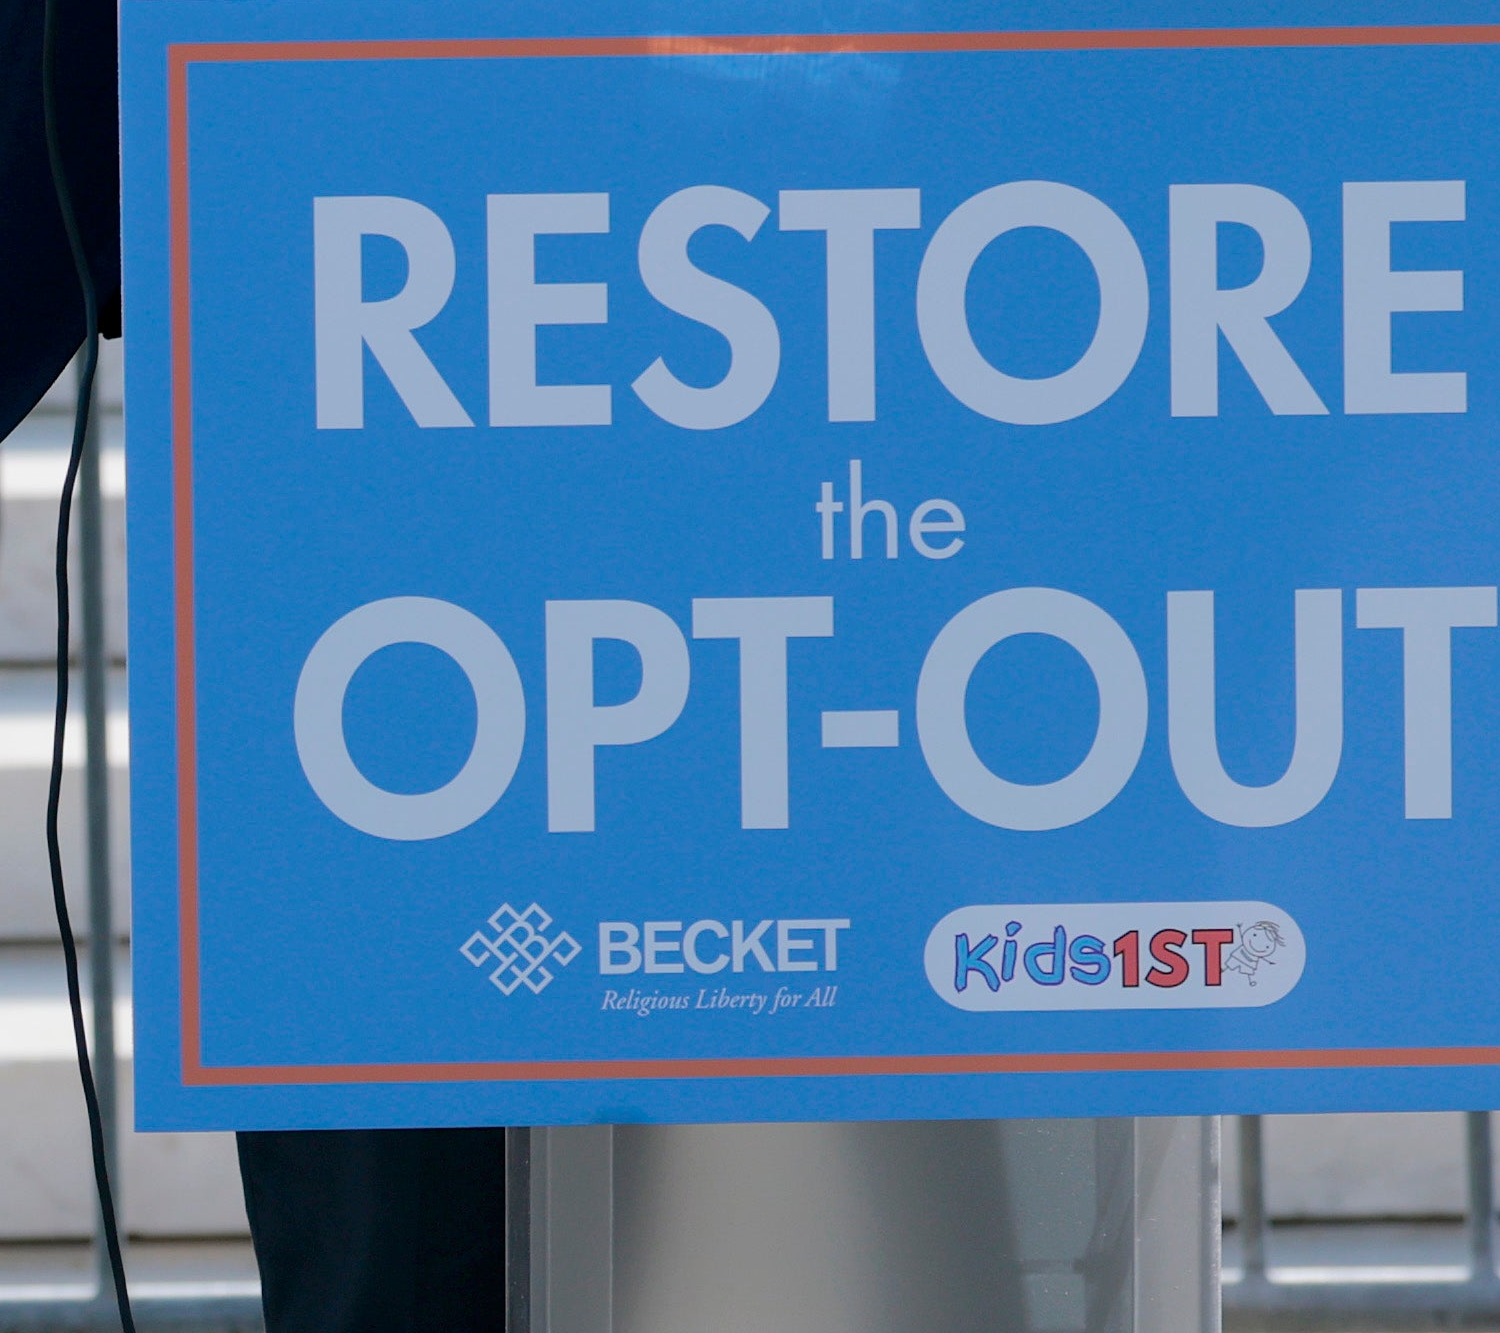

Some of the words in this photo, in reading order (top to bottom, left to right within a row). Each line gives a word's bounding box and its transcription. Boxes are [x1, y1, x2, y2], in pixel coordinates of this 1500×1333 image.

[313, 180, 1467, 430] RESTORE
[816, 459, 965, 559] the
[294, 586, 1498, 841] OPT-OUT
[599, 919, 850, 974] BECKET
[954, 921, 1233, 993] Kids1ST
[601, 989, 690, 1017] Religious
[695, 987, 768, 1015] Liberty
[770, 986, 802, 1015] for
[803, 986, 839, 1008] All
